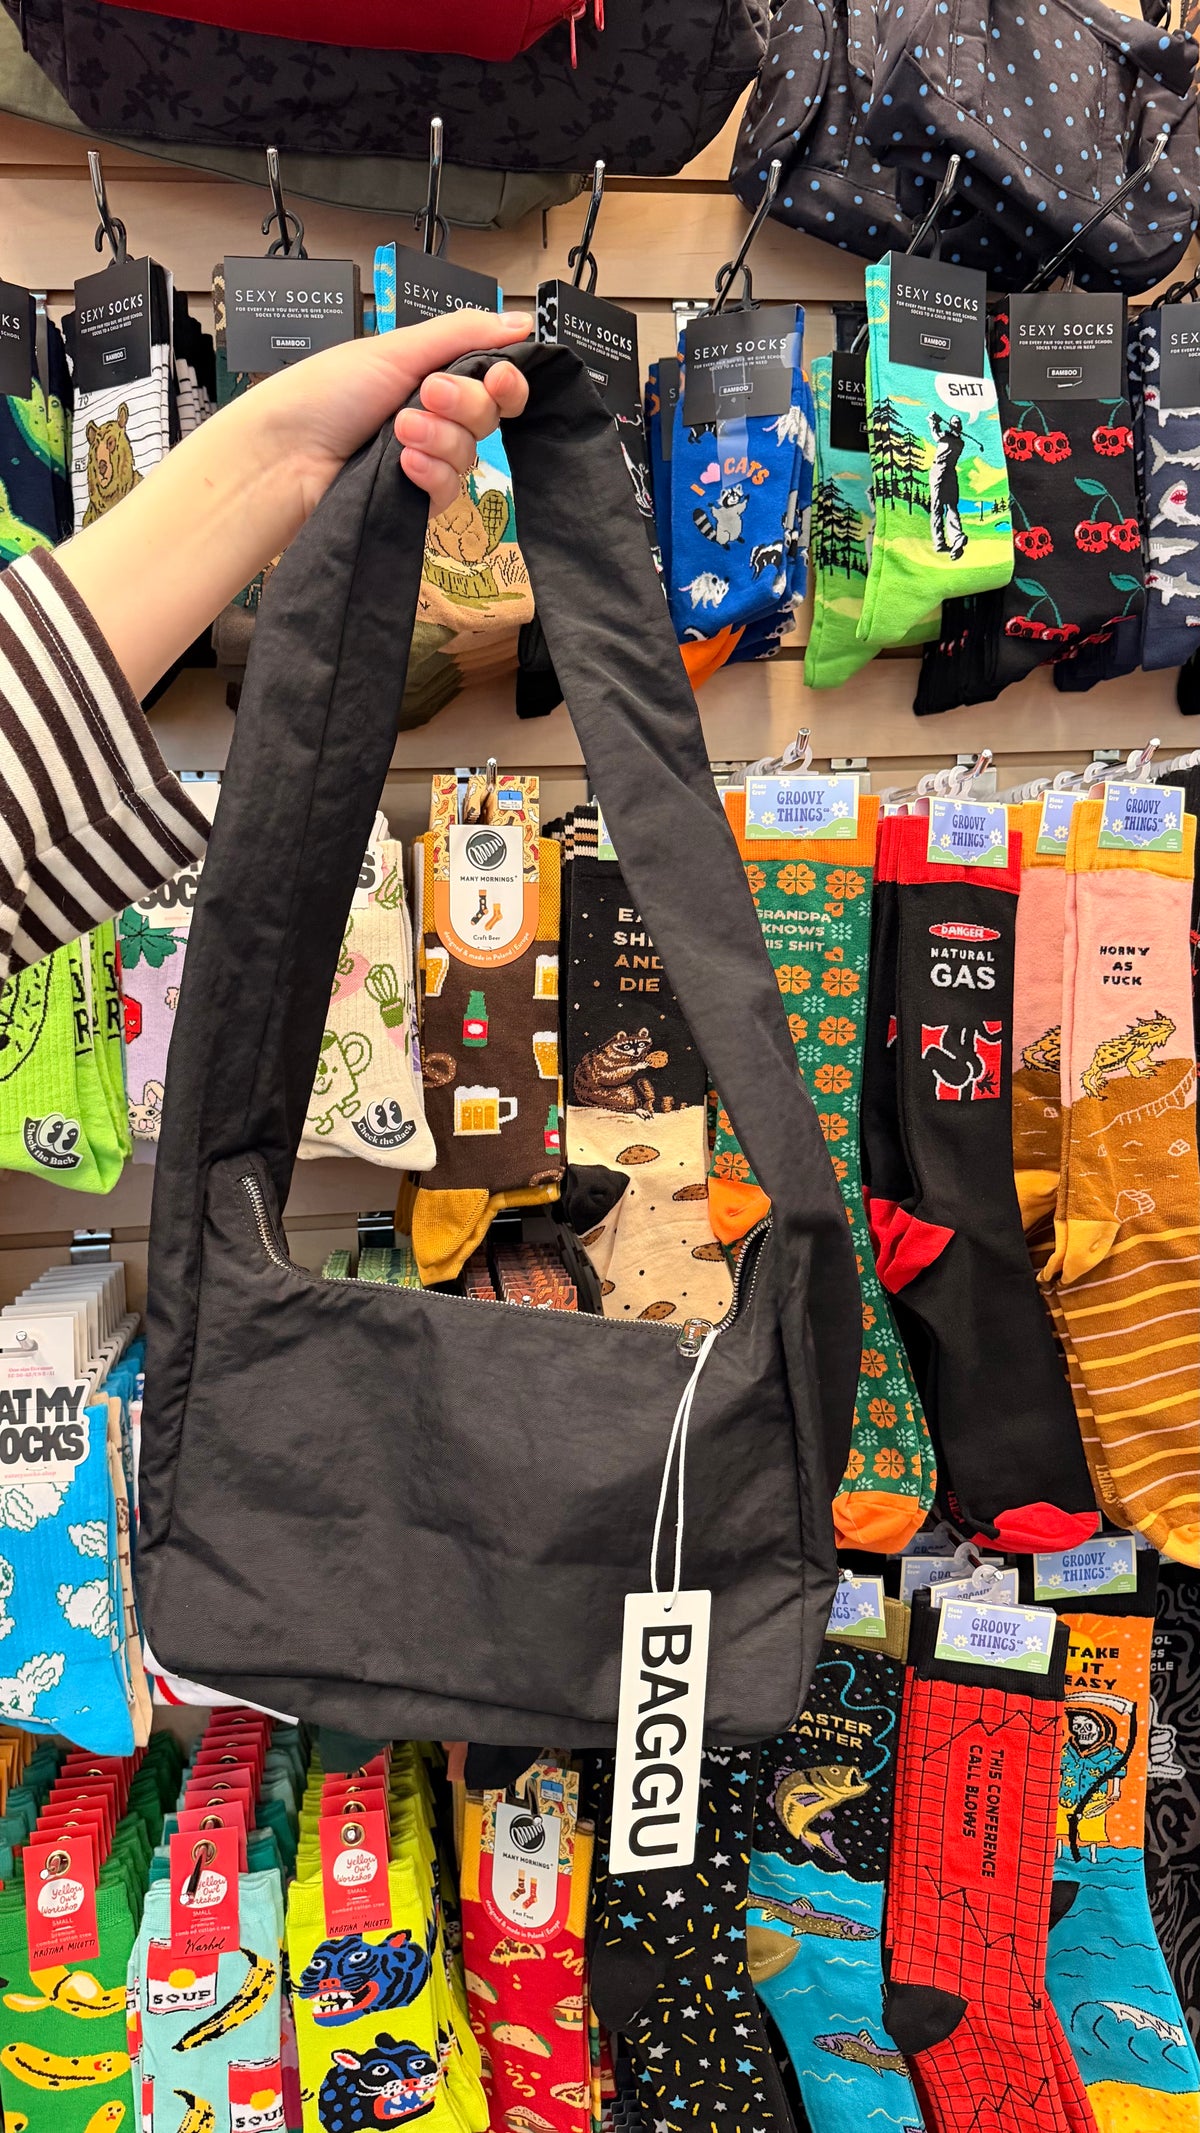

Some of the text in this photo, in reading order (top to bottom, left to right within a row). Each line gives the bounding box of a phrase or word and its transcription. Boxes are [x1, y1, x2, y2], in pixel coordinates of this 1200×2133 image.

[235, 289, 344, 305] SEXY SOCKS
[404, 281, 439, 302] SEXY
[896, 283, 979, 312] SEXY SOCKS
[80, 293, 144, 324] SEXY SOCKS
[962, 313, 978, 321] SCHOOL
[564, 313, 592, 334] SEXY
[596, 326, 632, 351] SOCKS
[1019, 323, 1114, 336] SEXY SOCKS
[923, 336, 947, 347] BAMBOO
[1170, 331, 1200, 345] SEX
[694, 338, 787, 360] SEXY SOCKS
[723, 385, 749, 393] BAMBOO
[837, 379, 866, 394] SEXY
[948, 382, 984, 396] SHIT
[690, 456, 770, 497] I CATS
[777, 790, 825, 805] GROOVY
[1125, 798, 1161, 815] GROOVY
[777, 807, 824, 822] THINGS
[952, 814, 986, 831] GROOVY
[1124, 815, 1159, 832] THINGS
[952, 831, 985, 848] THINGS
[761, 922, 825, 937] KNOWS
[941, 925, 984, 938] DANGER
[468, 952, 485, 961] made
[493, 949, 513, 960] Poland
[514, 932, 530, 951] Europe
[613, 931, 654, 947] SH
[788, 940, 825, 952] SHIT
[930, 947, 995, 962] NATURAL
[1099, 945, 1150, 956] HORNY
[614, 953, 664, 969] AND
[1112, 961, 1133, 971] AS
[619, 976, 660, 992] DIE
[930, 963, 996, 990] GAS
[1103, 975, 1142, 986] FUCK
[358, 1122, 413, 1145] Check the Back
[27, 1122, 75, 1165] Check the Back
[0, 1385, 86, 1425] AT MY
[0, 1423, 84, 1465] OCKS
[1062, 1552, 1106, 1567] GROOVY
[1063, 1567, 1106, 1582] THINGS
[971, 1618, 1021, 1636] GROOVY
[970, 1633, 1016, 1651] THINGS
[1068, 1646, 1119, 1659] TAKE
[1082, 1662, 1104, 1675] IT
[1064, 1674, 1117, 1690] EASY
[799, 1710, 872, 1737] ASTER
[628, 1624, 693, 1857] BAGGU
[962, 1745, 983, 1838] CALL BLOWS
[982, 1749, 1004, 1878] THIS CONFERENCE
[346, 1854, 376, 1869] Yellow
[354, 1863, 371, 1874] Owl
[502, 1852, 550, 1870] MANY MORNINGS
[198, 1875, 226, 1890] ellow
[337, 1873, 372, 1883] Workshop
[51, 1883, 83, 1900] Yellow
[59, 1892, 77, 1904] Owl
[203, 1886, 220, 1895] Owl
[195, 1894, 221, 1904] rkshop
[41, 1902, 78, 1914] Workshop
[192, 1909, 212, 1917] SMALL
[332, 1906, 353, 1914] combed
[52, 1918, 73, 1926] SMALL
[153, 1989, 211, 2005] SOUP
